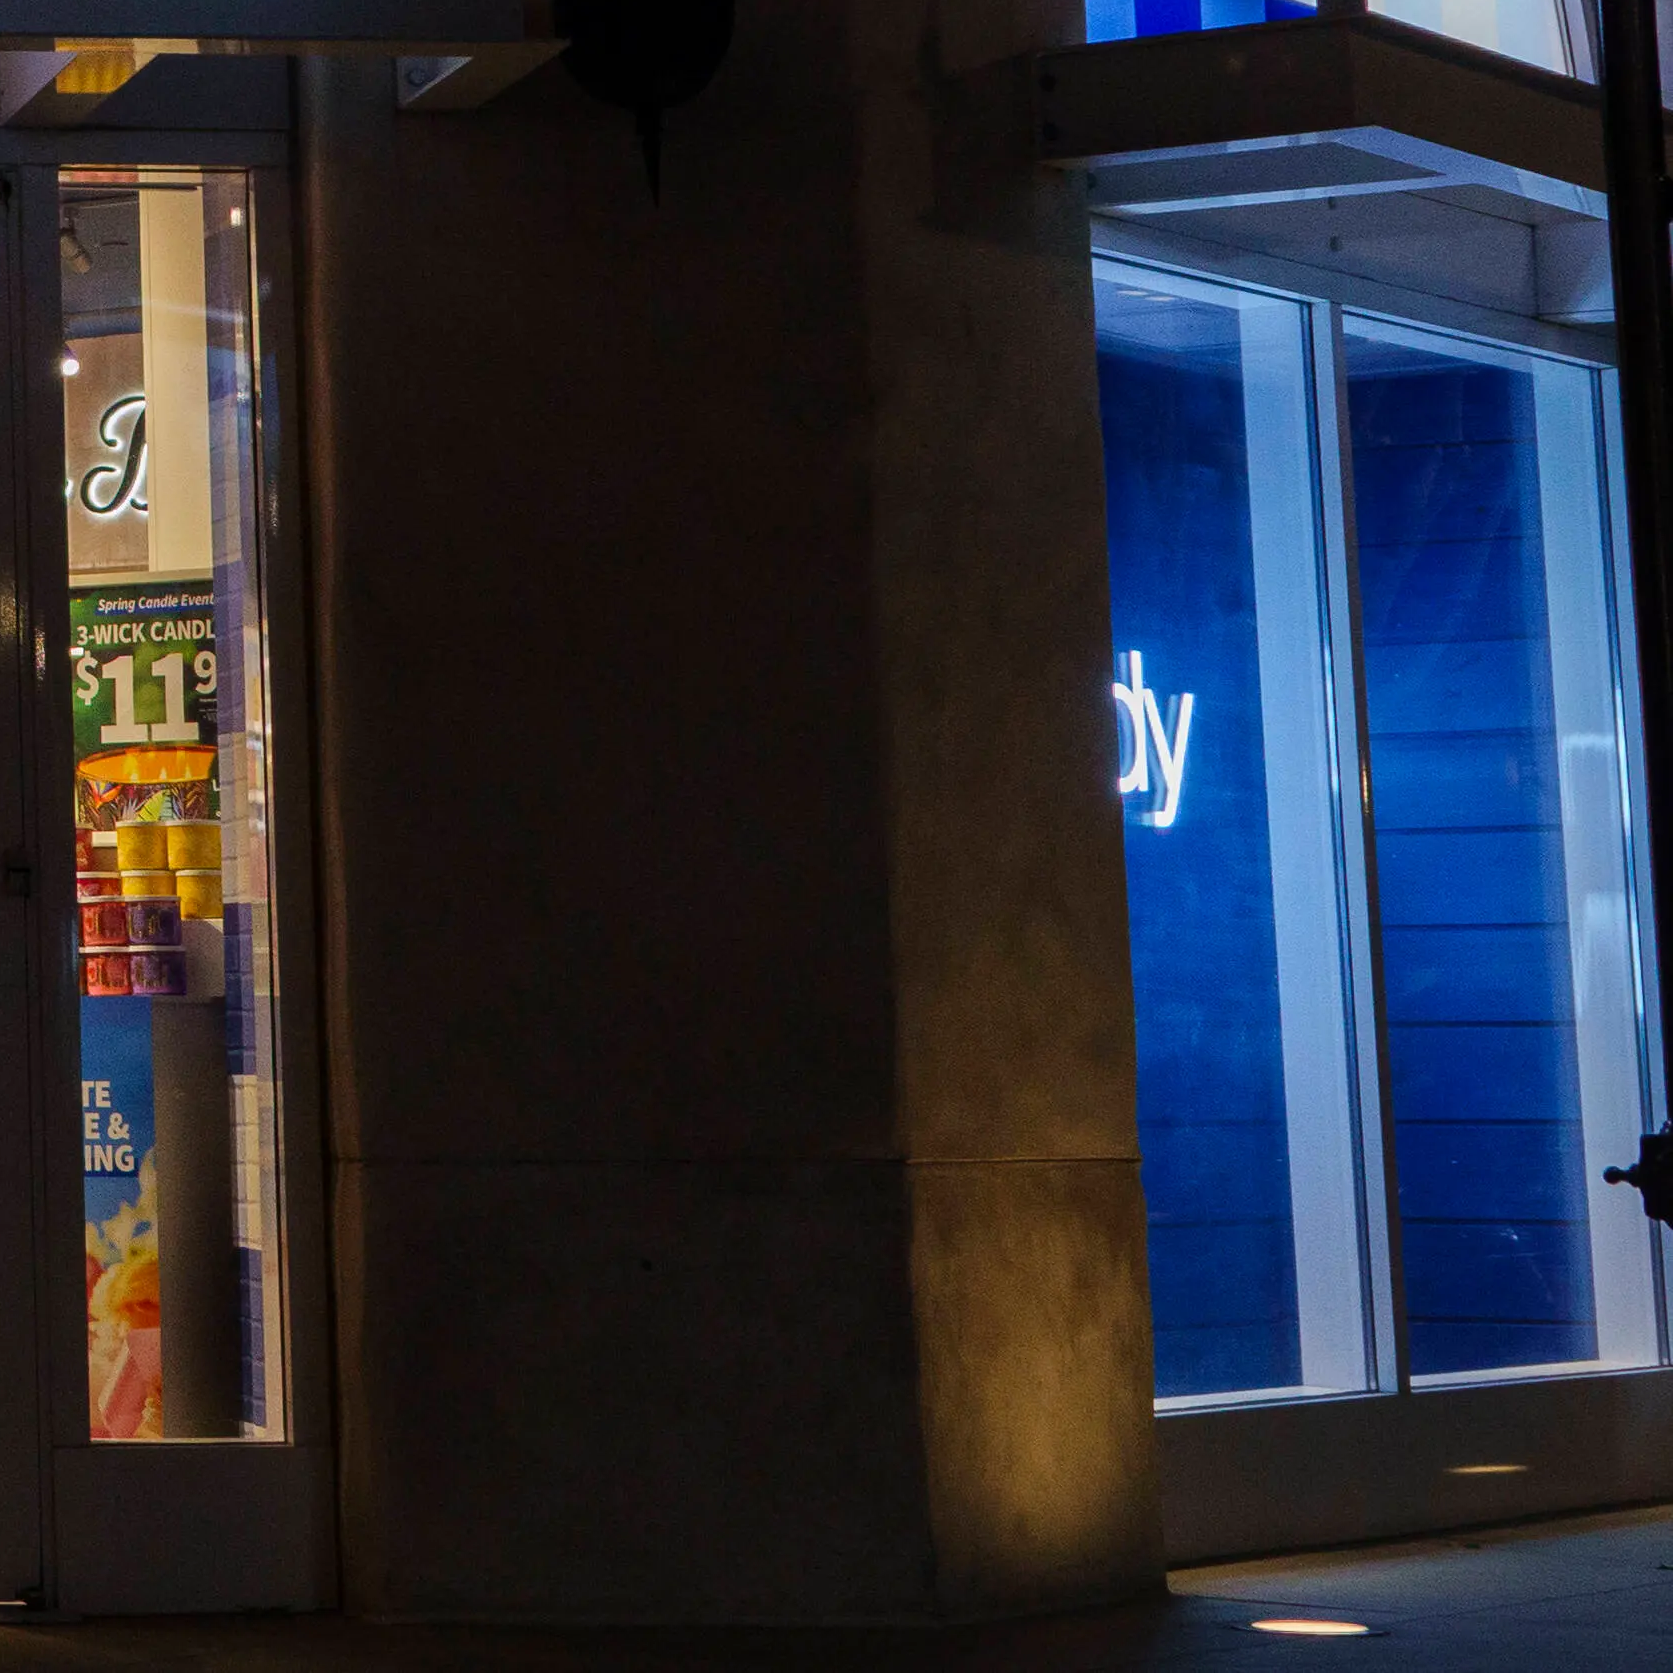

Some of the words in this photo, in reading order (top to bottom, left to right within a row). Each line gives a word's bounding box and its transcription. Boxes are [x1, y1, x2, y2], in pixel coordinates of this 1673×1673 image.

[97, 598, 136, 614] Spring
[138, 594, 178, 609] Candle
[181, 593, 215, 606] Event
[76, 622, 146, 646] 3-WICK
[107, 1112, 130, 1140] &
[84, 1145, 135, 1172] ING
